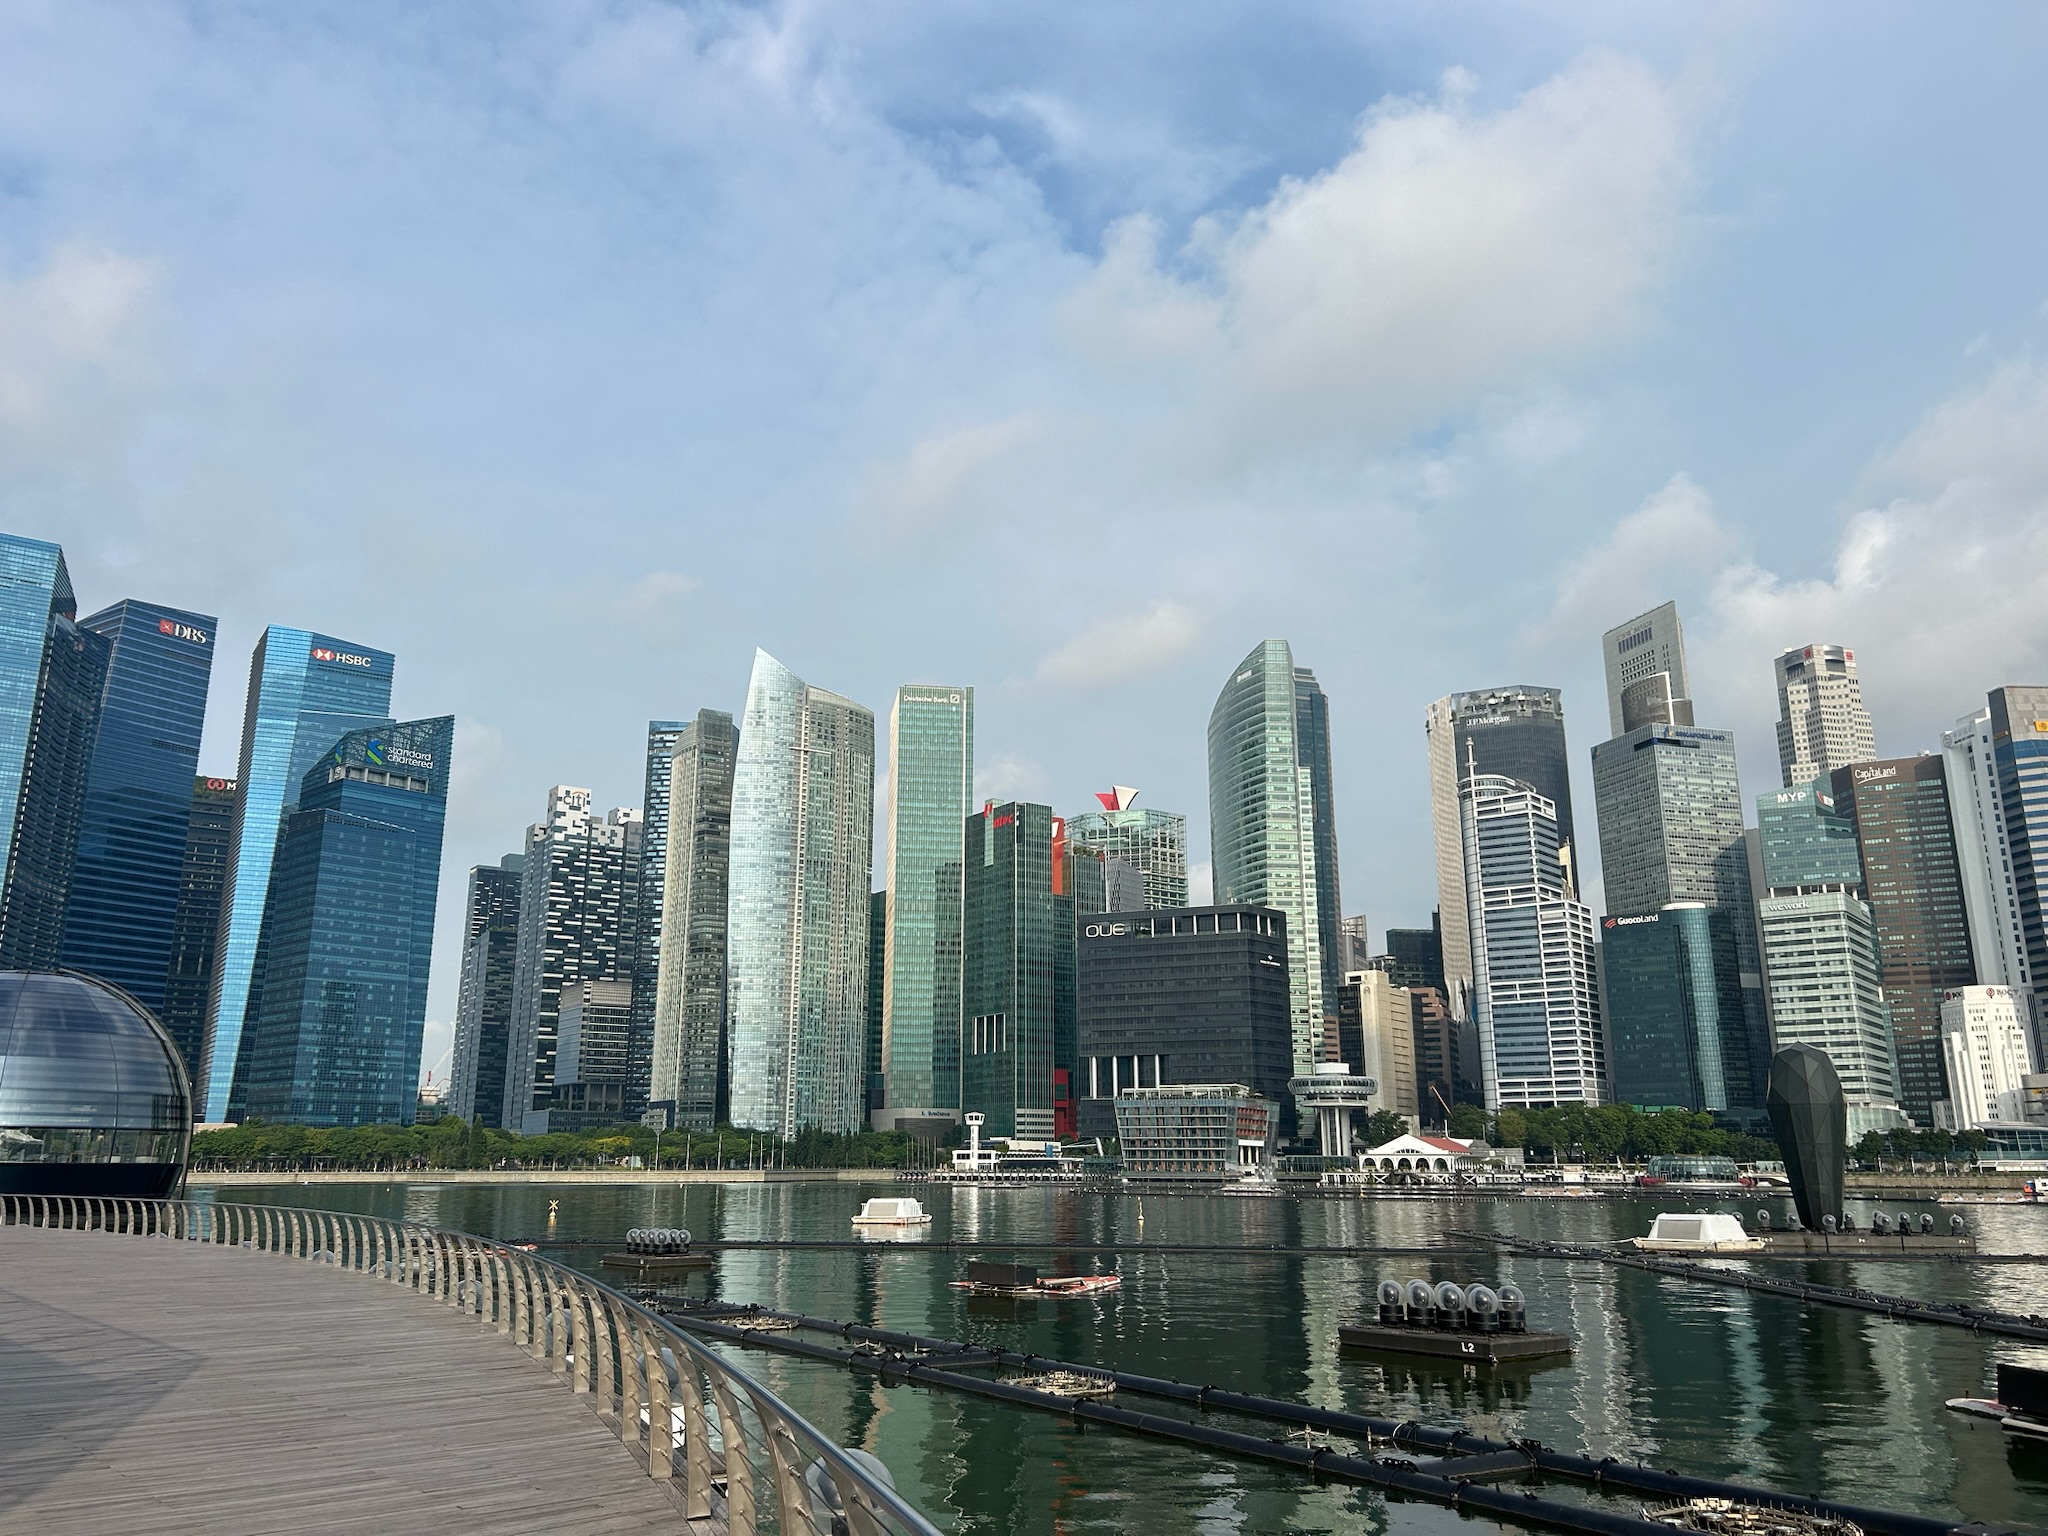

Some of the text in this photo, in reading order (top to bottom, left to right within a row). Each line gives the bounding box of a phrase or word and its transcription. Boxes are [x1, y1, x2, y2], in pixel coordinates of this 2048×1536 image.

[174, 623, 207, 644] DBS
[335, 652, 372, 668] HSBC
[904, 694, 949, 704] Deutsche Bank
[387, 746, 432, 761] standard
[387, 753, 433, 769] chartered
[1854, 766, 1896, 780] CapitaLand
[226, 782, 237, 791] M
[563, 794, 586, 808] citi
[1777, 792, 1807, 803] MYP
[1768, 899, 1811, 911] wework
[1617, 913, 1659, 926] GuocoLand
[1085, 923, 1126, 938] OUE
[1460, 1341, 1475, 1353] L2
